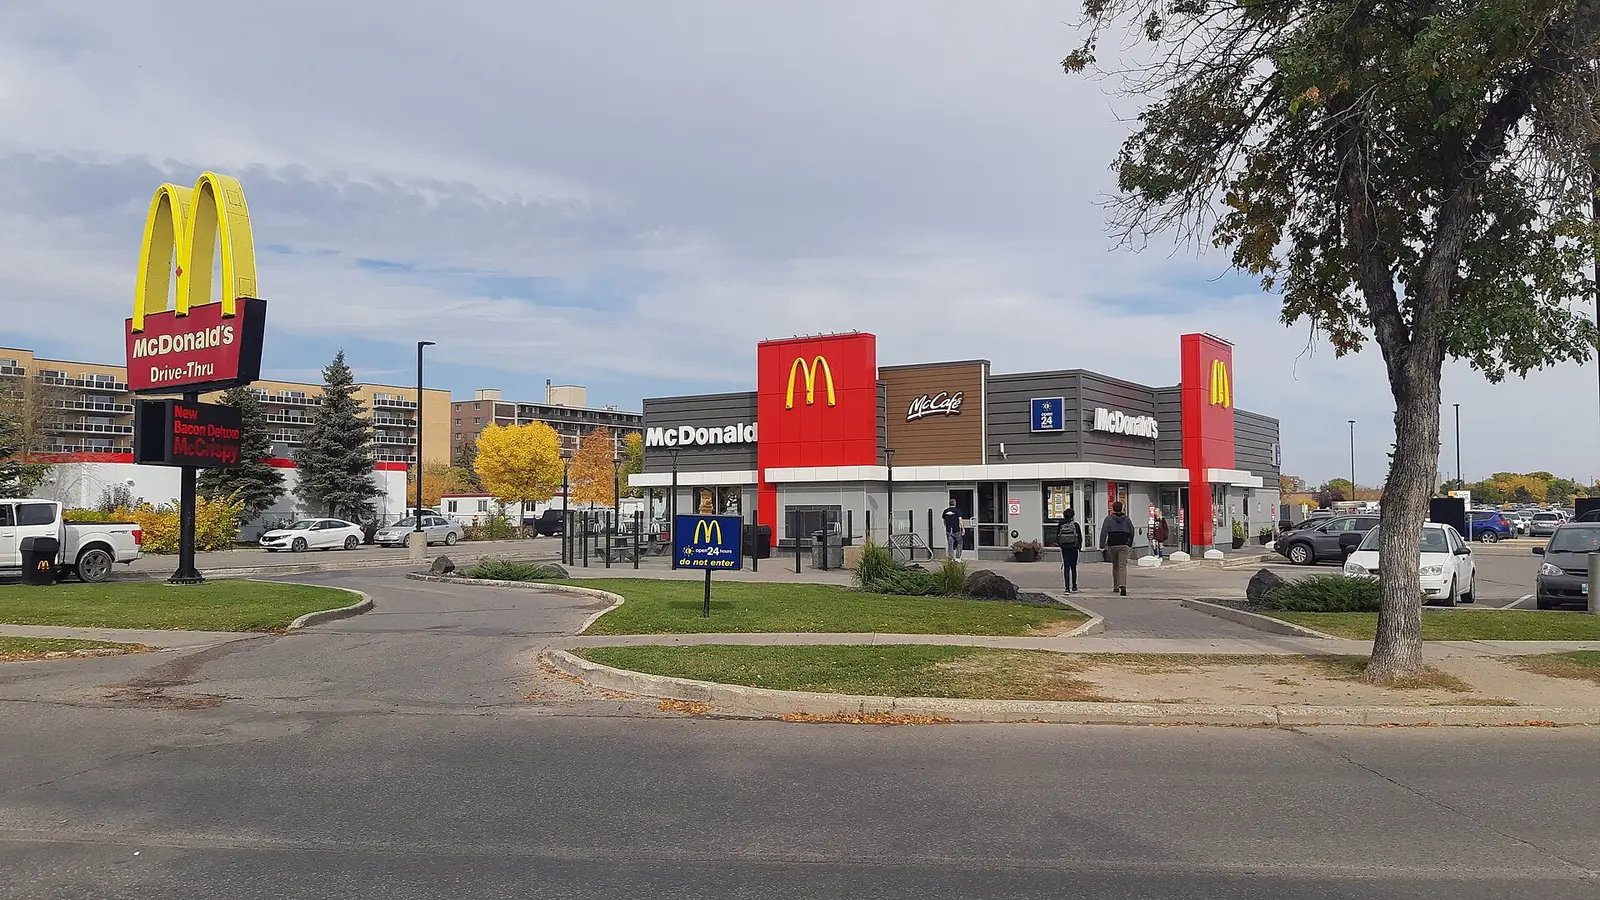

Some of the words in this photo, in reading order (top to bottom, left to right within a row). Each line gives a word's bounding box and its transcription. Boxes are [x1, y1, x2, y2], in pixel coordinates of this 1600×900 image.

[132, 324, 234, 359] McDonald's
[150, 361, 214, 383] Drive-Thru
[174, 404, 198, 420] New
[907, 391, 963, 420] McCafé
[173, 419, 206, 437] Bacon
[207, 423, 240, 440] Deluxe
[1040, 416, 1053, 425] 24
[1093, 407, 1159, 439] McDonald's
[173, 436, 239, 465] McCrispy
[707, 546, 720, 556] 24
[679, 558, 691, 566] do
